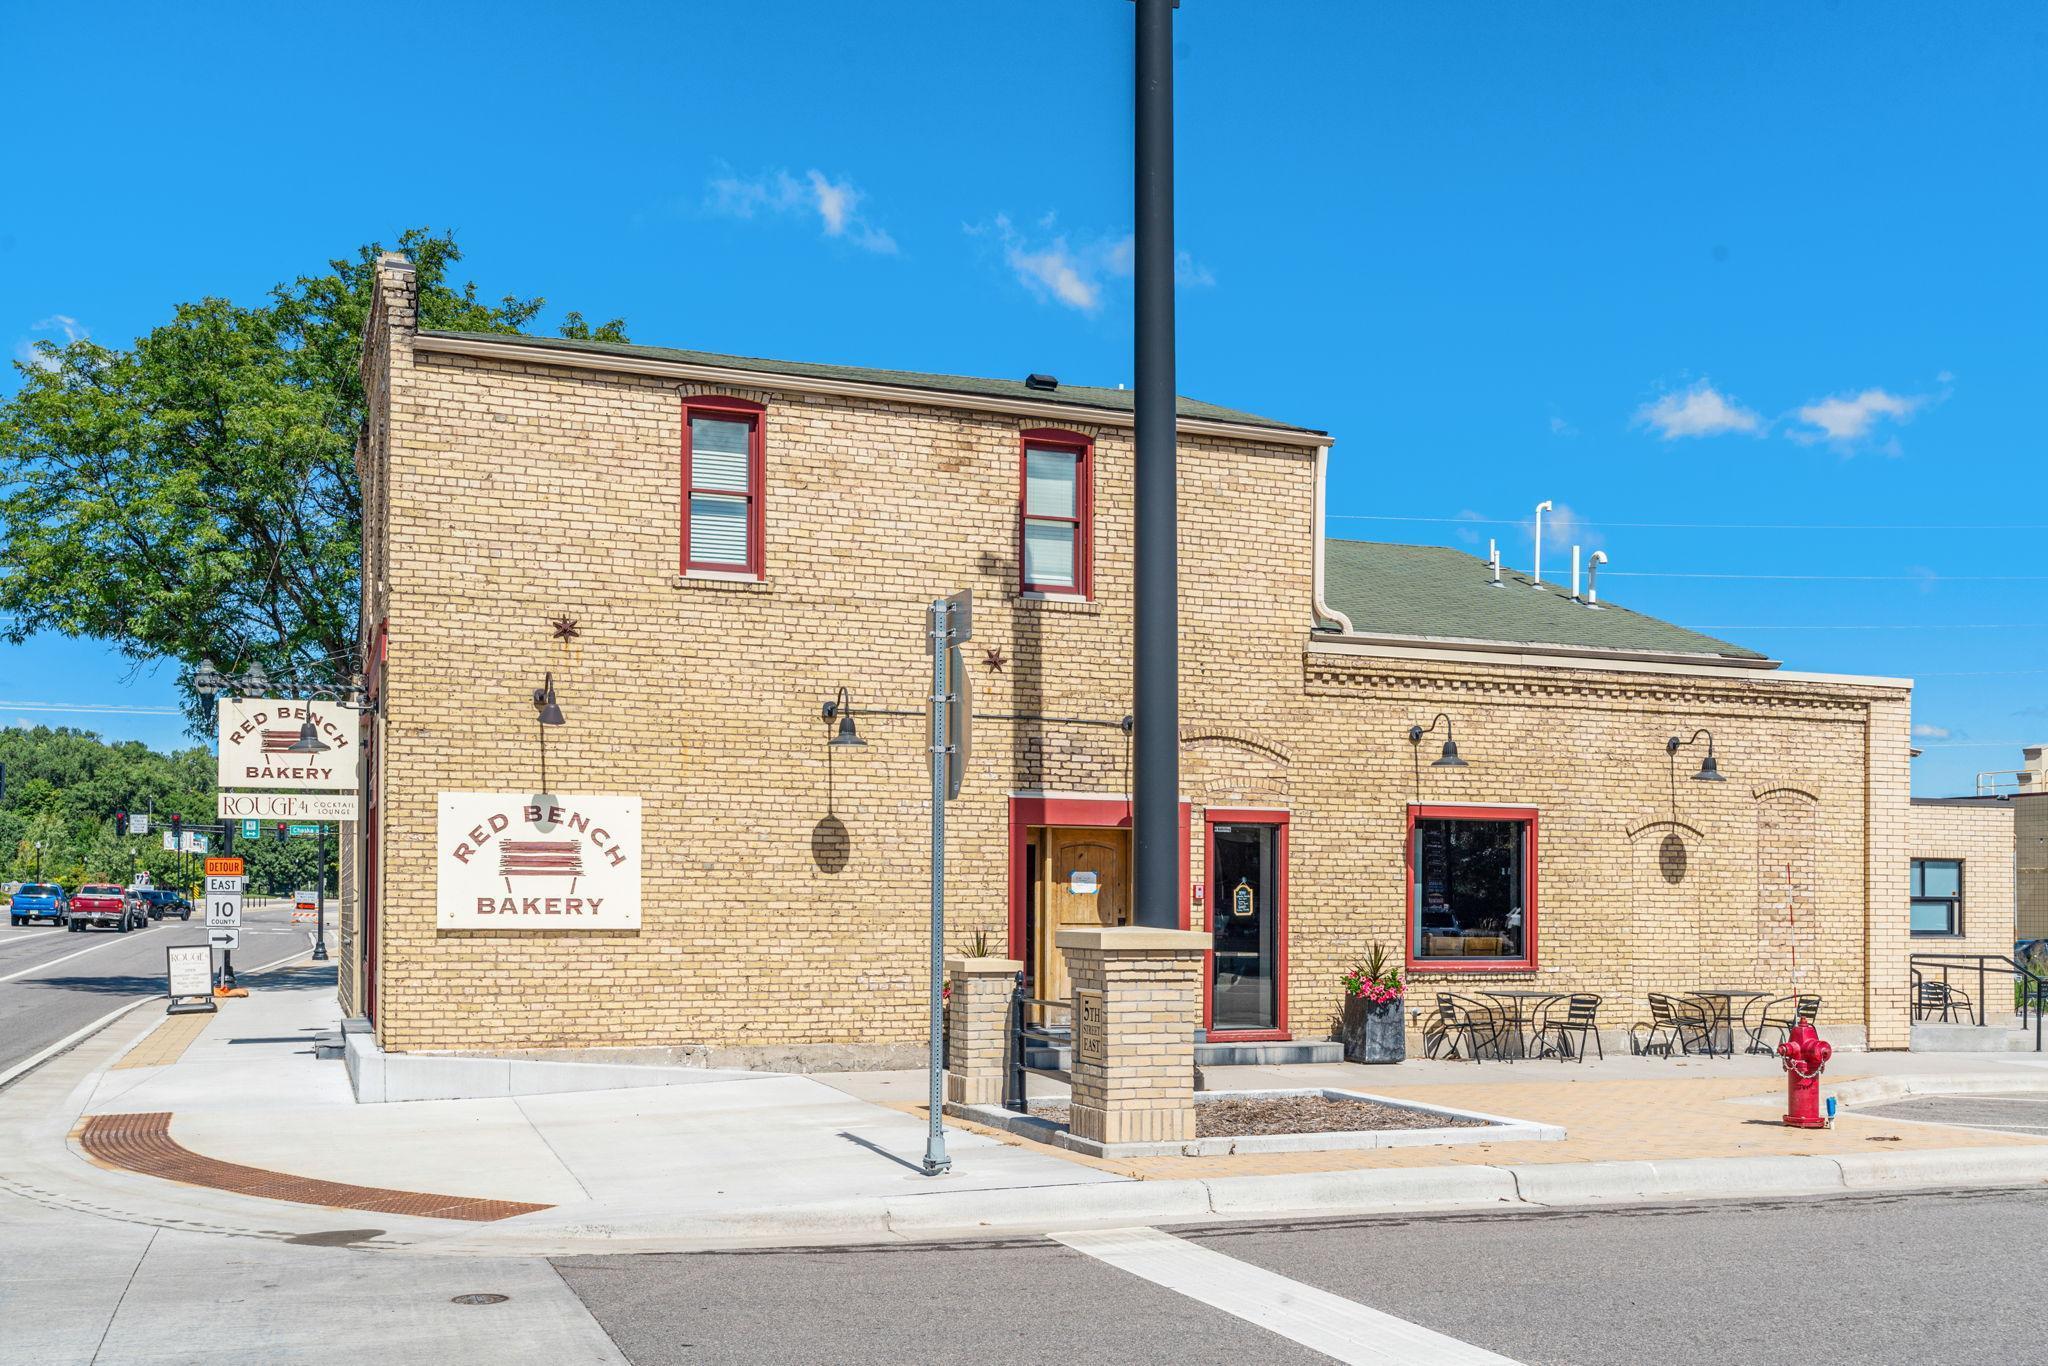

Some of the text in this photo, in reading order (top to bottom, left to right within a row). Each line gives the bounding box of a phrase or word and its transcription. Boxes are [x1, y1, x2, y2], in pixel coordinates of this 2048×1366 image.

[229, 707, 349, 749] RED BENCH
[246, 766, 333, 780] BAKERY
[223, 796, 298, 817] ROUGE
[452, 805, 627, 868] RED BENCH
[209, 862, 240, 872] DETOUR
[211, 879, 237, 890] EAST
[214, 902, 234, 917] 10
[477, 897, 605, 915] BAKERY
[1083, 1000, 1100, 1023] 5TH
[1083, 1024, 1101, 1036] STREET
[1083, 1038, 1101, 1053] EAST
